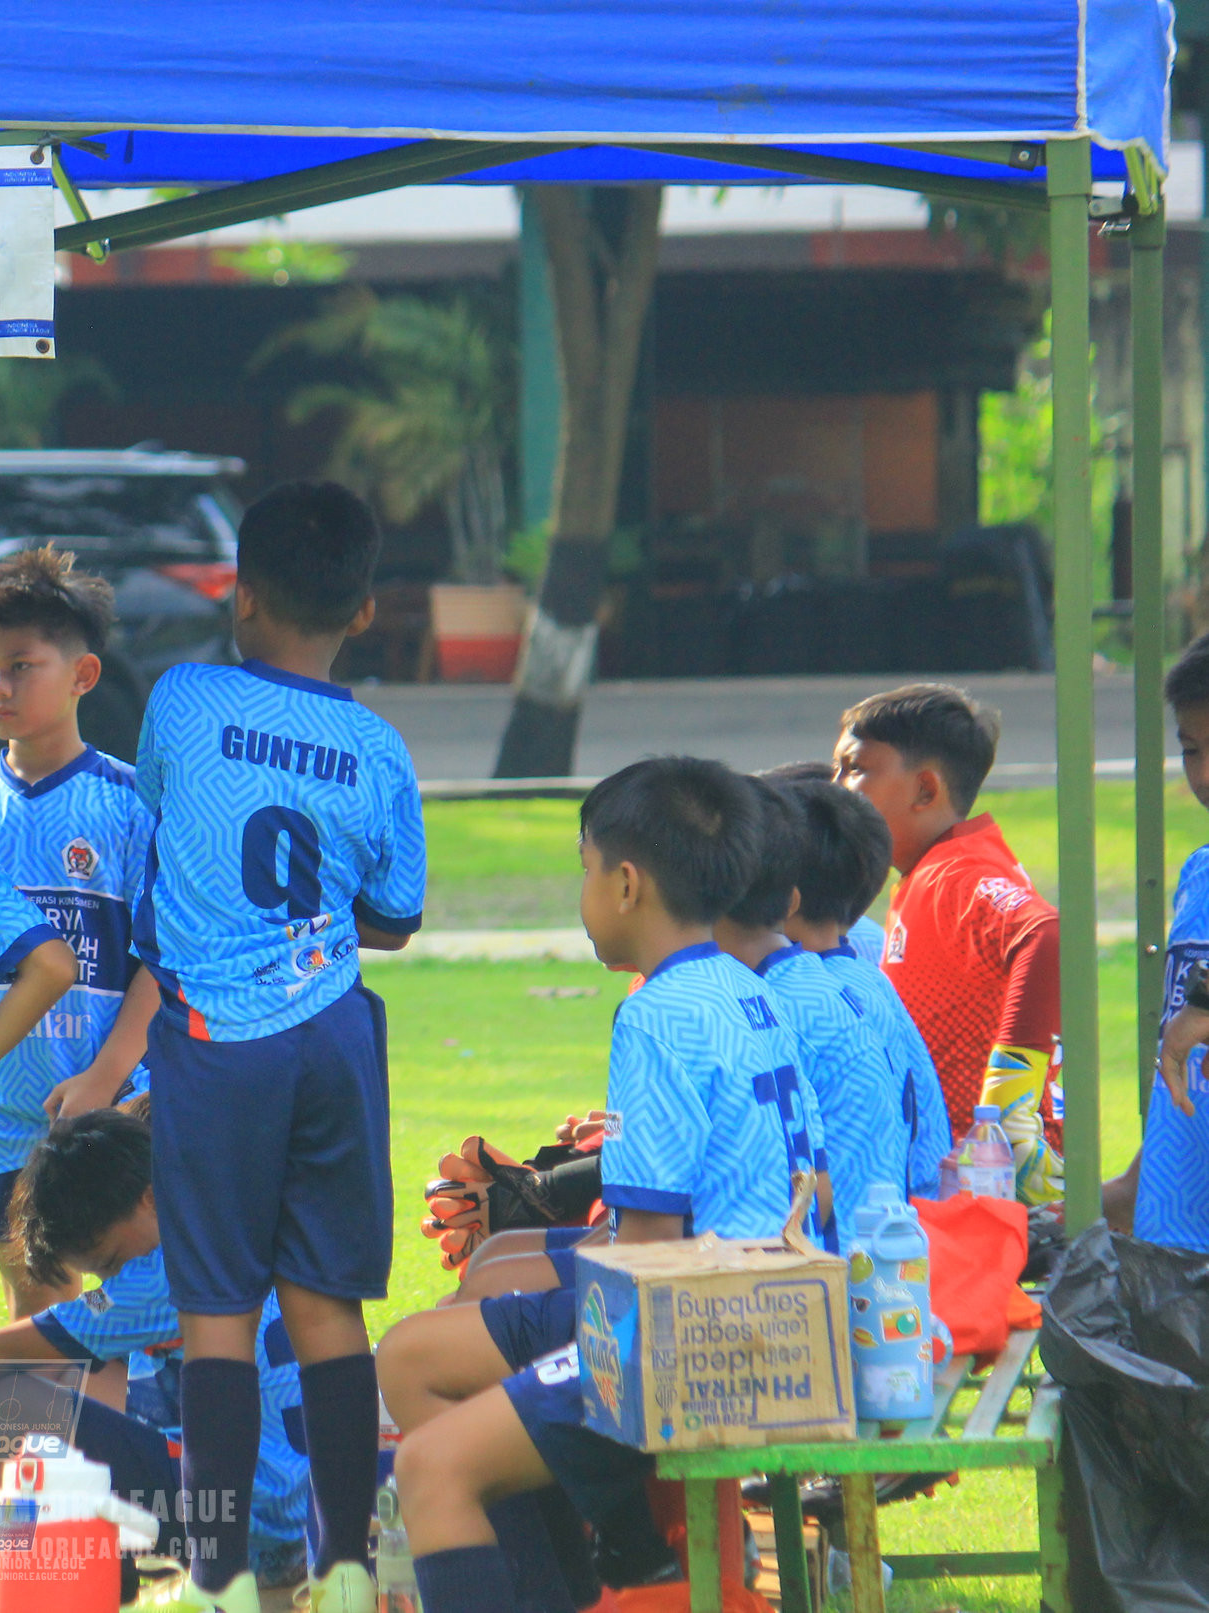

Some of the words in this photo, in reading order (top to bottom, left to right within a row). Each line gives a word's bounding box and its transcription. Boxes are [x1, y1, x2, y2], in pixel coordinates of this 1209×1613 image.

[221, 725, 358, 788] GUNTUR
[759, 1317, 810, 1338] Lebih
[684, 1347, 755, 1372] ideal
[760, 1345, 812, 1365] Lebih
[685, 1374, 769, 1399] NETRAL
[774, 1375, 813, 1402] PH
